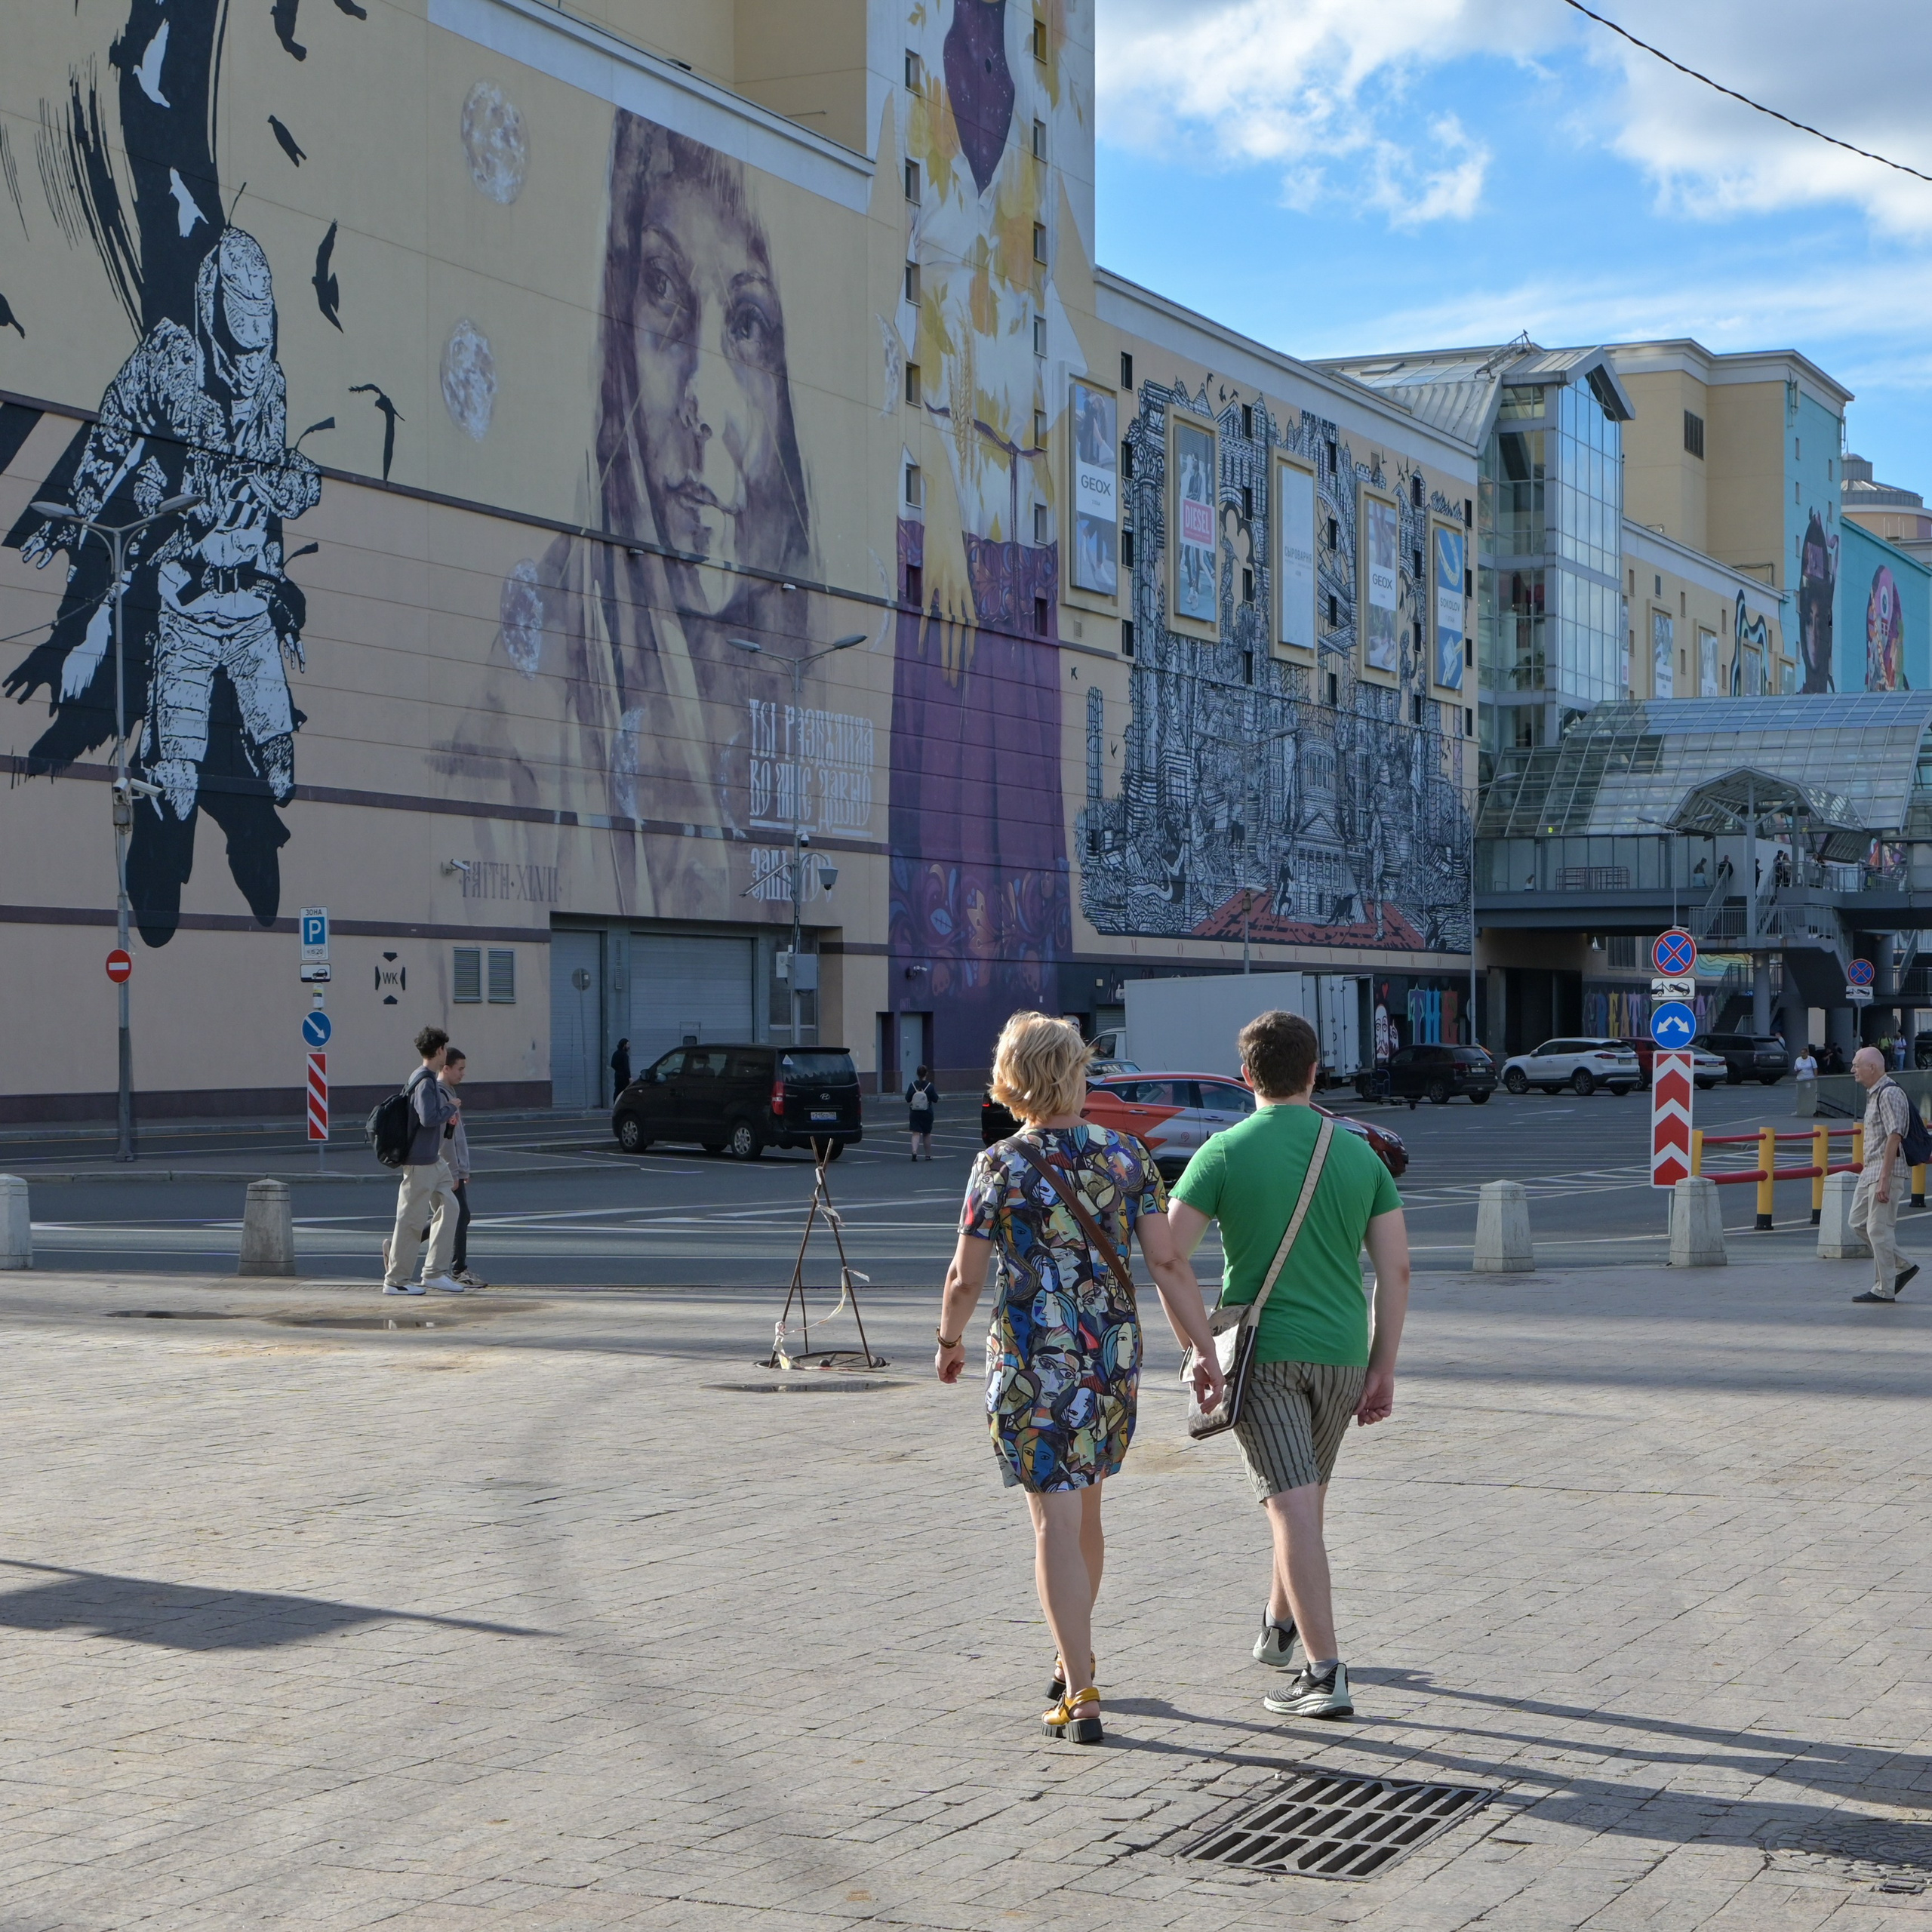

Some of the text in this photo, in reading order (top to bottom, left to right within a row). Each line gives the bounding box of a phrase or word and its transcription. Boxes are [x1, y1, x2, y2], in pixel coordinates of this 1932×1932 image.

[1081, 474, 1112, 497] GEOX
[1185, 504, 1211, 535] DIESEL
[1284, 545, 1312, 565] СЫРОВАРНЯ
[1372, 573, 1393, 591] GEOX
[1440, 597, 1461, 612] SOKOLOV
[309, 919, 322, 943] P
[383, 972, 398, 985] WK
[1408, 983, 1458, 1045] THE
